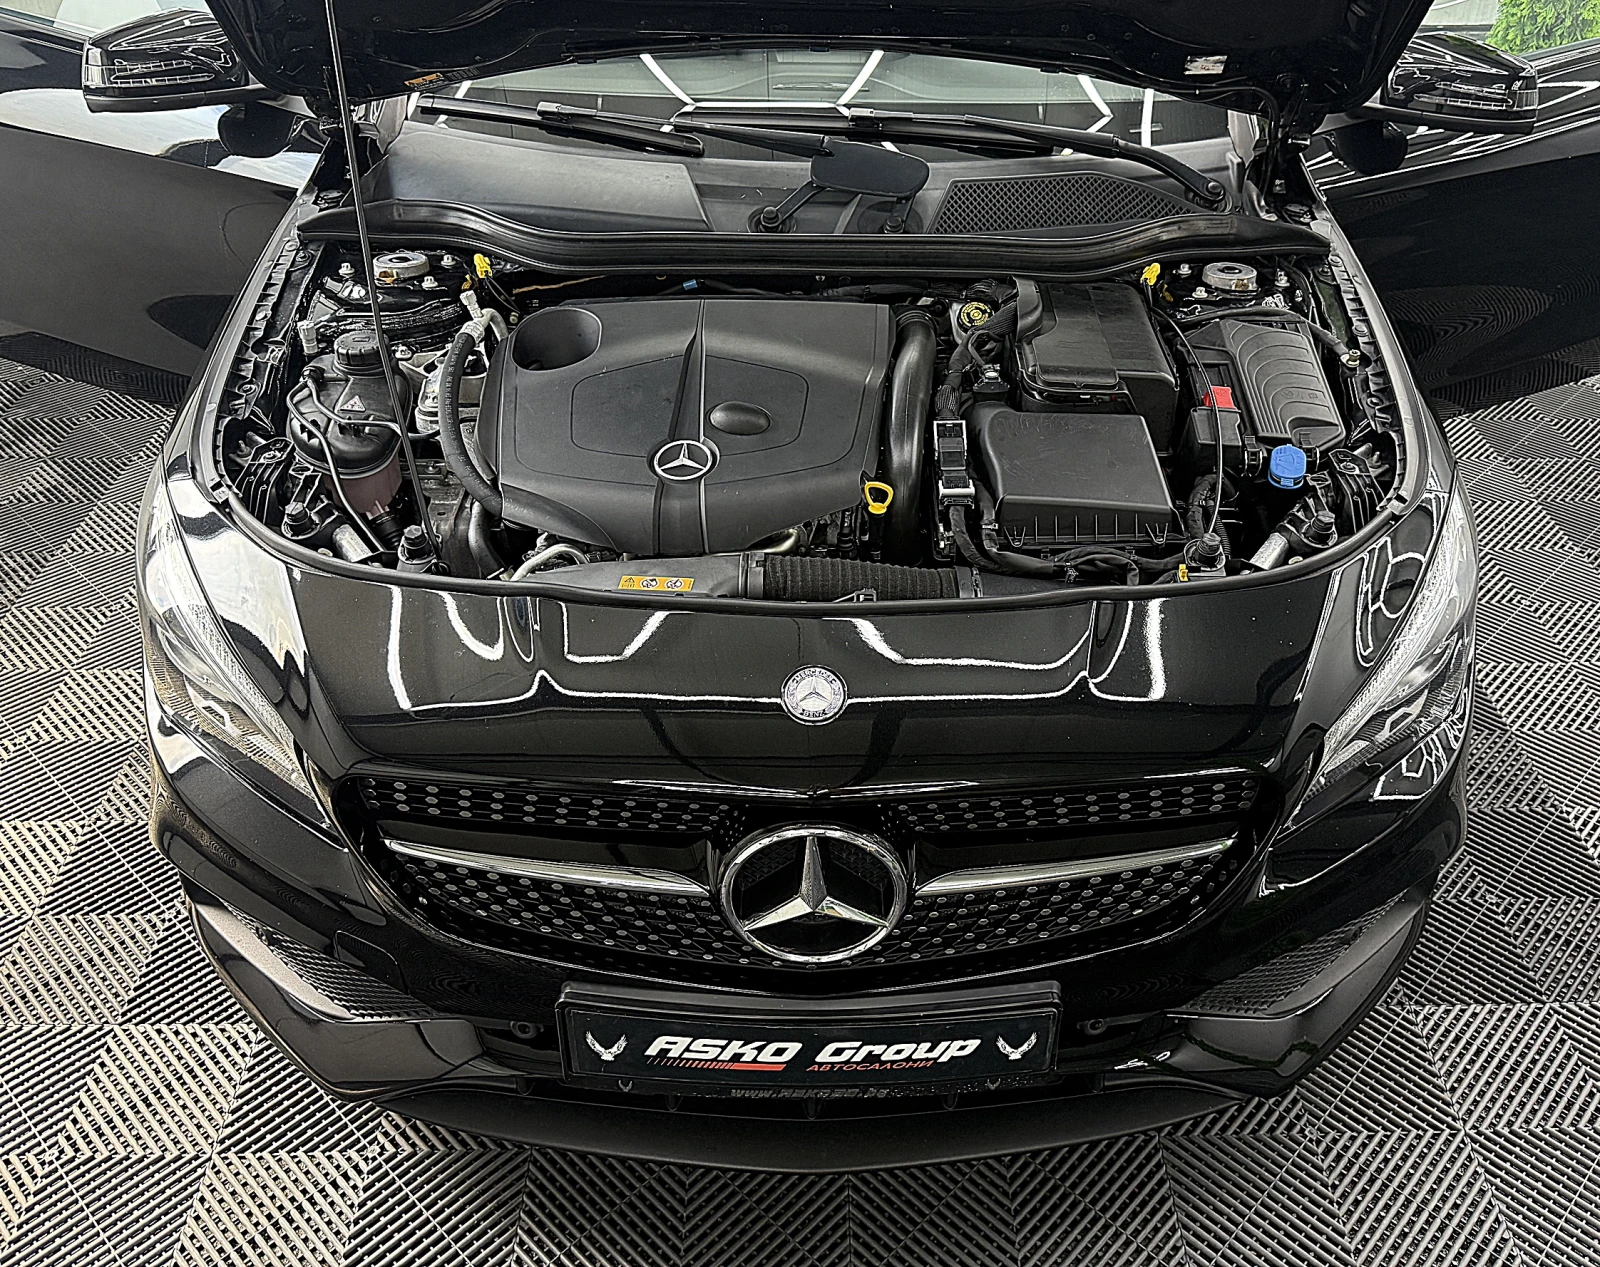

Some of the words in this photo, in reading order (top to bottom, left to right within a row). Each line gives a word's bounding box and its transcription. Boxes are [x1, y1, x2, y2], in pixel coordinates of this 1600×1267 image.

[644, 1035, 803, 1062] ASKO
[814, 1038, 982, 1063] Group
[805, 1060, 935, 1072] АВТОСАЛОНИ
